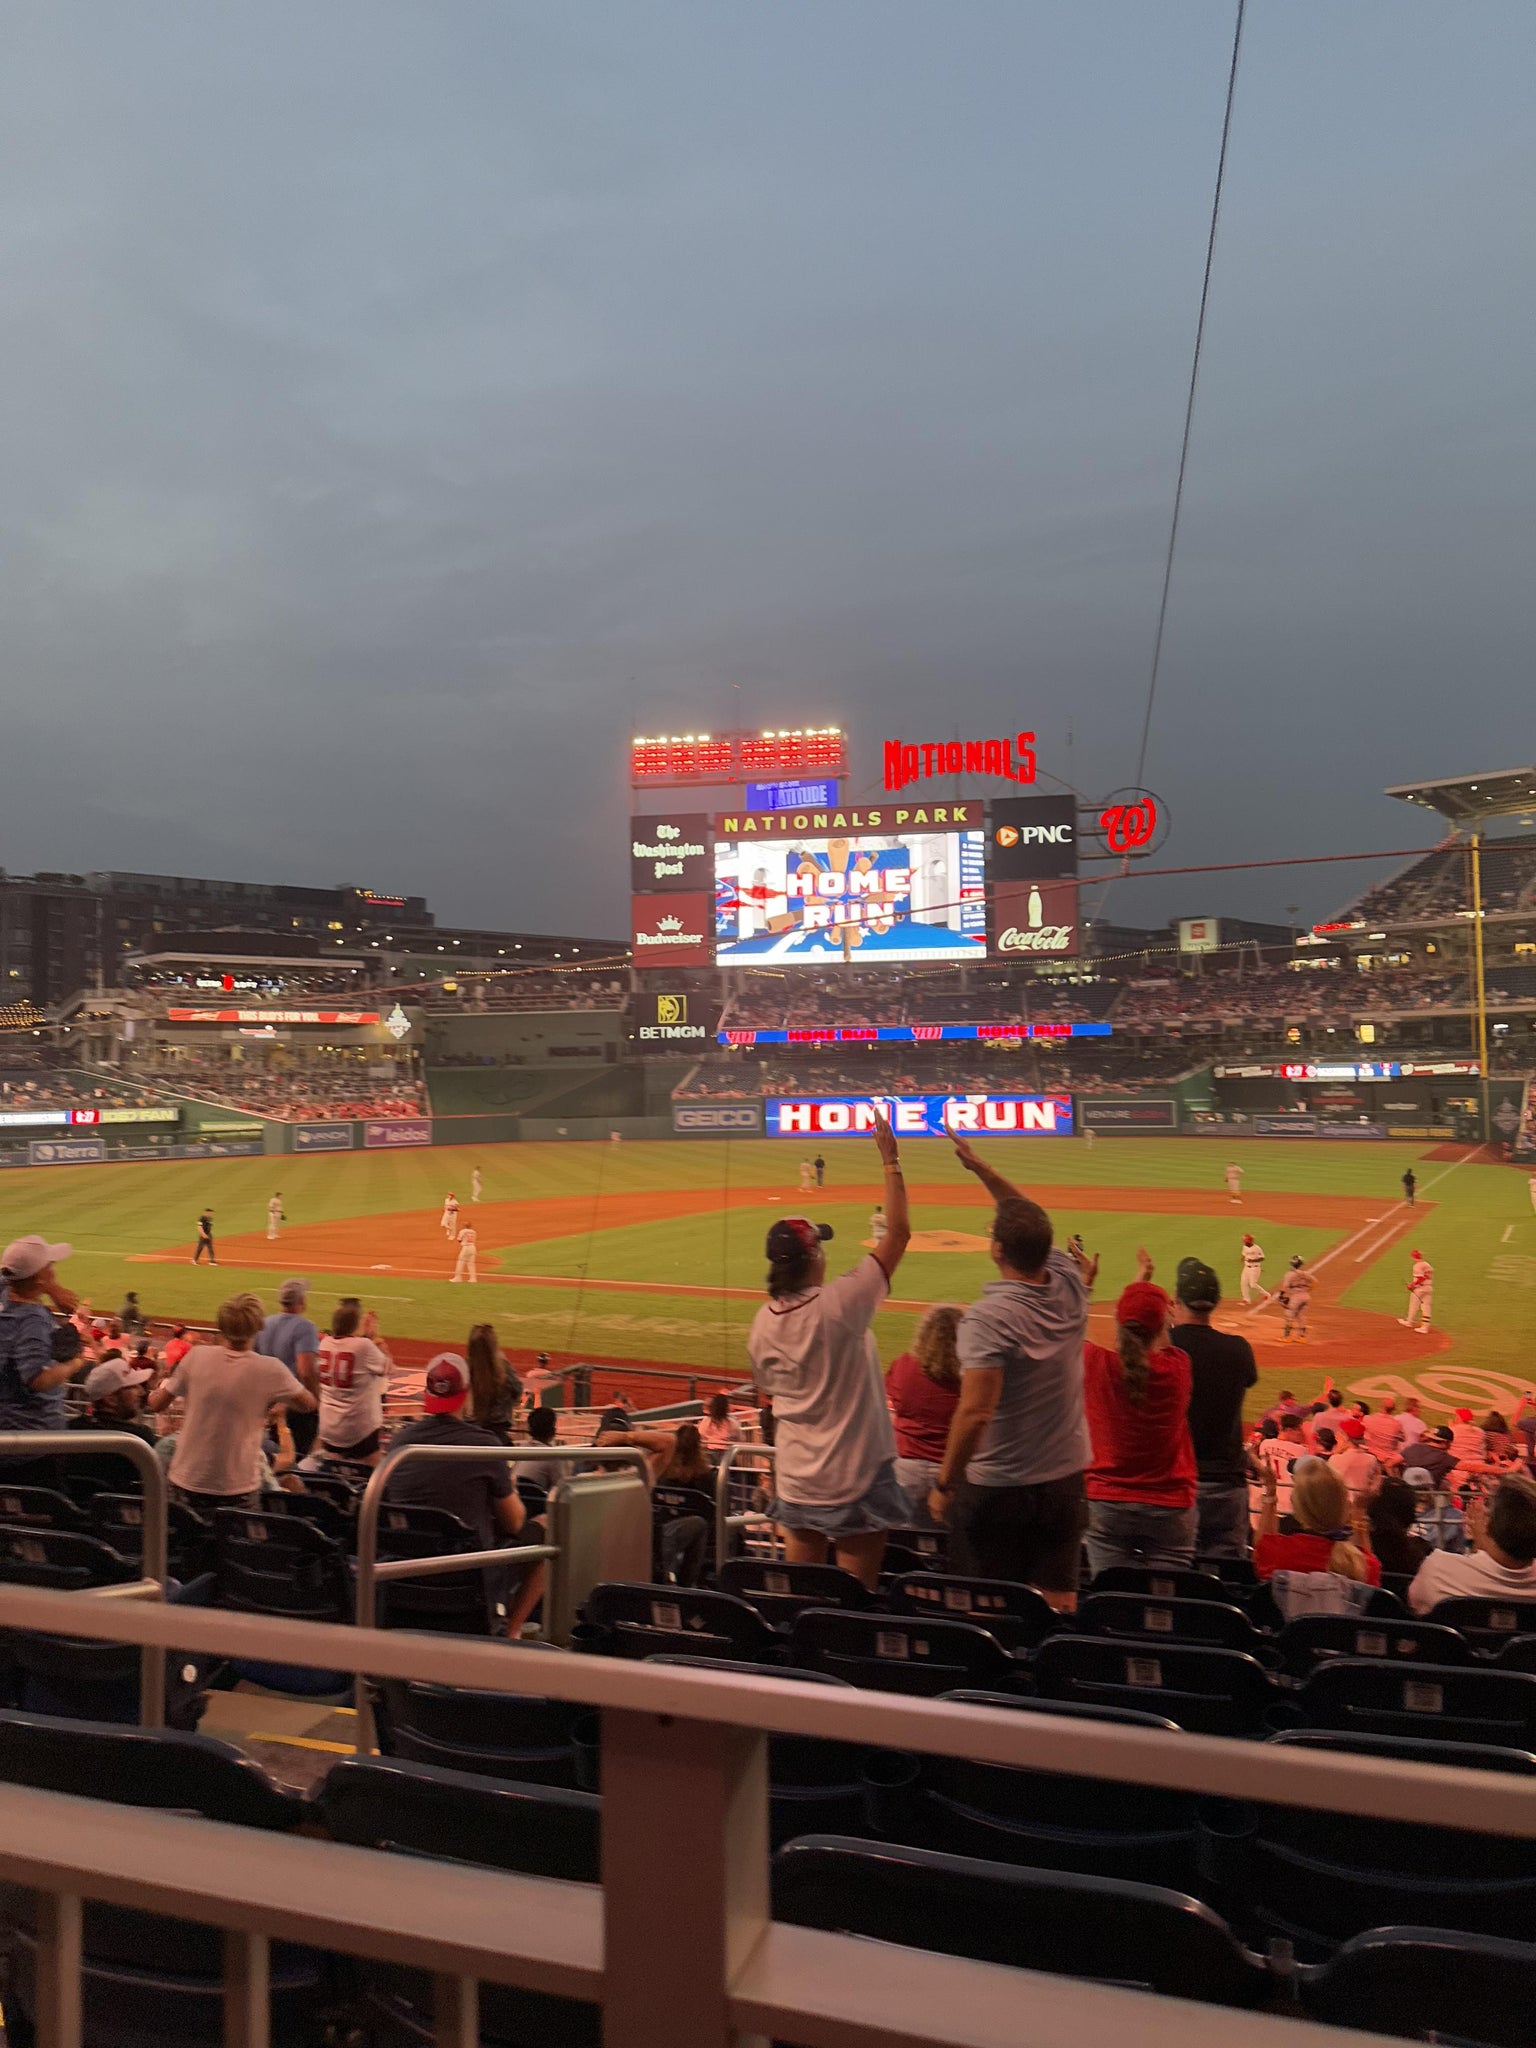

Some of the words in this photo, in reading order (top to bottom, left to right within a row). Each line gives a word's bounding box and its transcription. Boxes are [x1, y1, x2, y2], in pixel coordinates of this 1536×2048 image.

[883, 731, 1036, 791] NATIONALS
[724, 811, 882, 833] NATIONALS
[895, 807, 968, 825] PARK
[656, 824, 681, 840] The
[1020, 825, 1073, 844] PNC
[633, 842, 706, 859] Washington
[654, 861, 684, 879] Post
[787, 868, 912, 897] HOME
[803, 902, 895, 928] RUN
[636, 932, 703, 945] Budweiser
[639, 1025, 706, 1039] BETMGM
[788, 1029, 838, 1042] HOME
[841, 1028, 879, 1040] RUN
[977, 1025, 1029, 1038] HOME
[1033, 1024, 1073, 1036] RUN
[676, 1110, 757, 1127] GEICO
[779, 1102, 927, 1133] HOME
[945, 1100, 1057, 1131] RUN
[55, 1145, 99, 1160] Terra
[319, 1350, 355, 1388] 20
